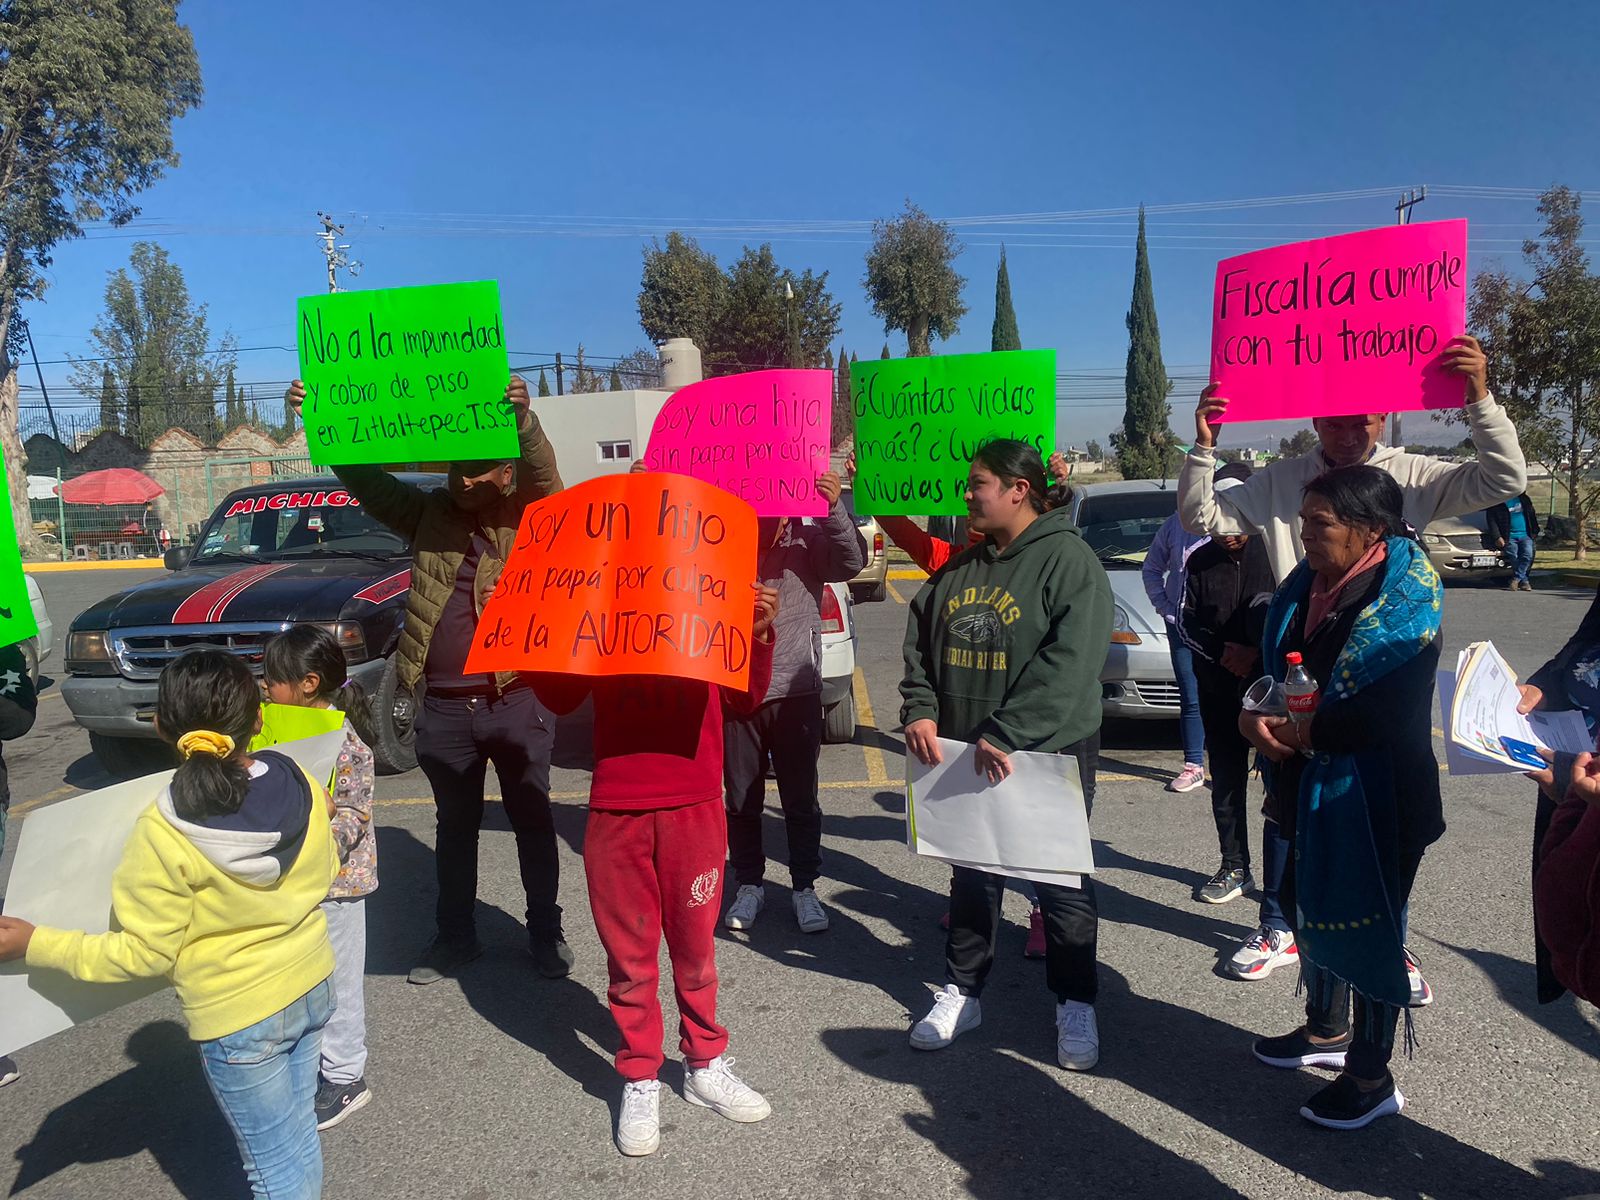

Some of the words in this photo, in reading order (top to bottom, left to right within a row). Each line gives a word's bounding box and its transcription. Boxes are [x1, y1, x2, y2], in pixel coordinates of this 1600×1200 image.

[1220, 256, 1356, 320] Fiscalía
[1369, 250, 1461, 301] cumple
[302, 307, 340, 366] No
[347, 329, 363, 359] a
[369, 312, 394, 360] la
[403, 313, 502, 358] impunidad
[1223, 334, 1272, 366] con
[1285, 323, 1323, 366] tu
[1336, 319, 1438, 367] trabajo
[308, 382, 320, 413] y
[329, 375, 378, 405] cobro
[390, 372, 416, 400] de
[426, 370, 469, 401] piso
[655, 398, 700, 440] Soy
[710, 401, 758, 427] una
[772, 383, 821, 442] hija
[854, 371, 957, 419] ¿Cuántas
[968, 376, 1035, 420] vidas
[317, 423, 342, 447] en
[347, 411, 469, 444] Zitlaltepec
[858, 422, 923, 463] más?
[650, 444, 681, 472] sin
[690, 442, 736, 476] papa
[745, 441, 775, 470] por
[780, 437, 826, 470] culpa
[224, 490, 361, 519] MICHIG
[863, 472, 944, 504] viudas
[517, 505, 570, 552] Soy
[585, 500, 630, 541] un
[657, 488, 726, 554] hijo
[494, 567, 533, 600] sin
[541, 560, 609, 601] papá
[615, 563, 654, 600] por
[663, 563, 727, 606] culpa
[483, 616, 514, 650] de
[523, 612, 549, 654] la
[571, 609, 748, 673] AUTORIDAD
